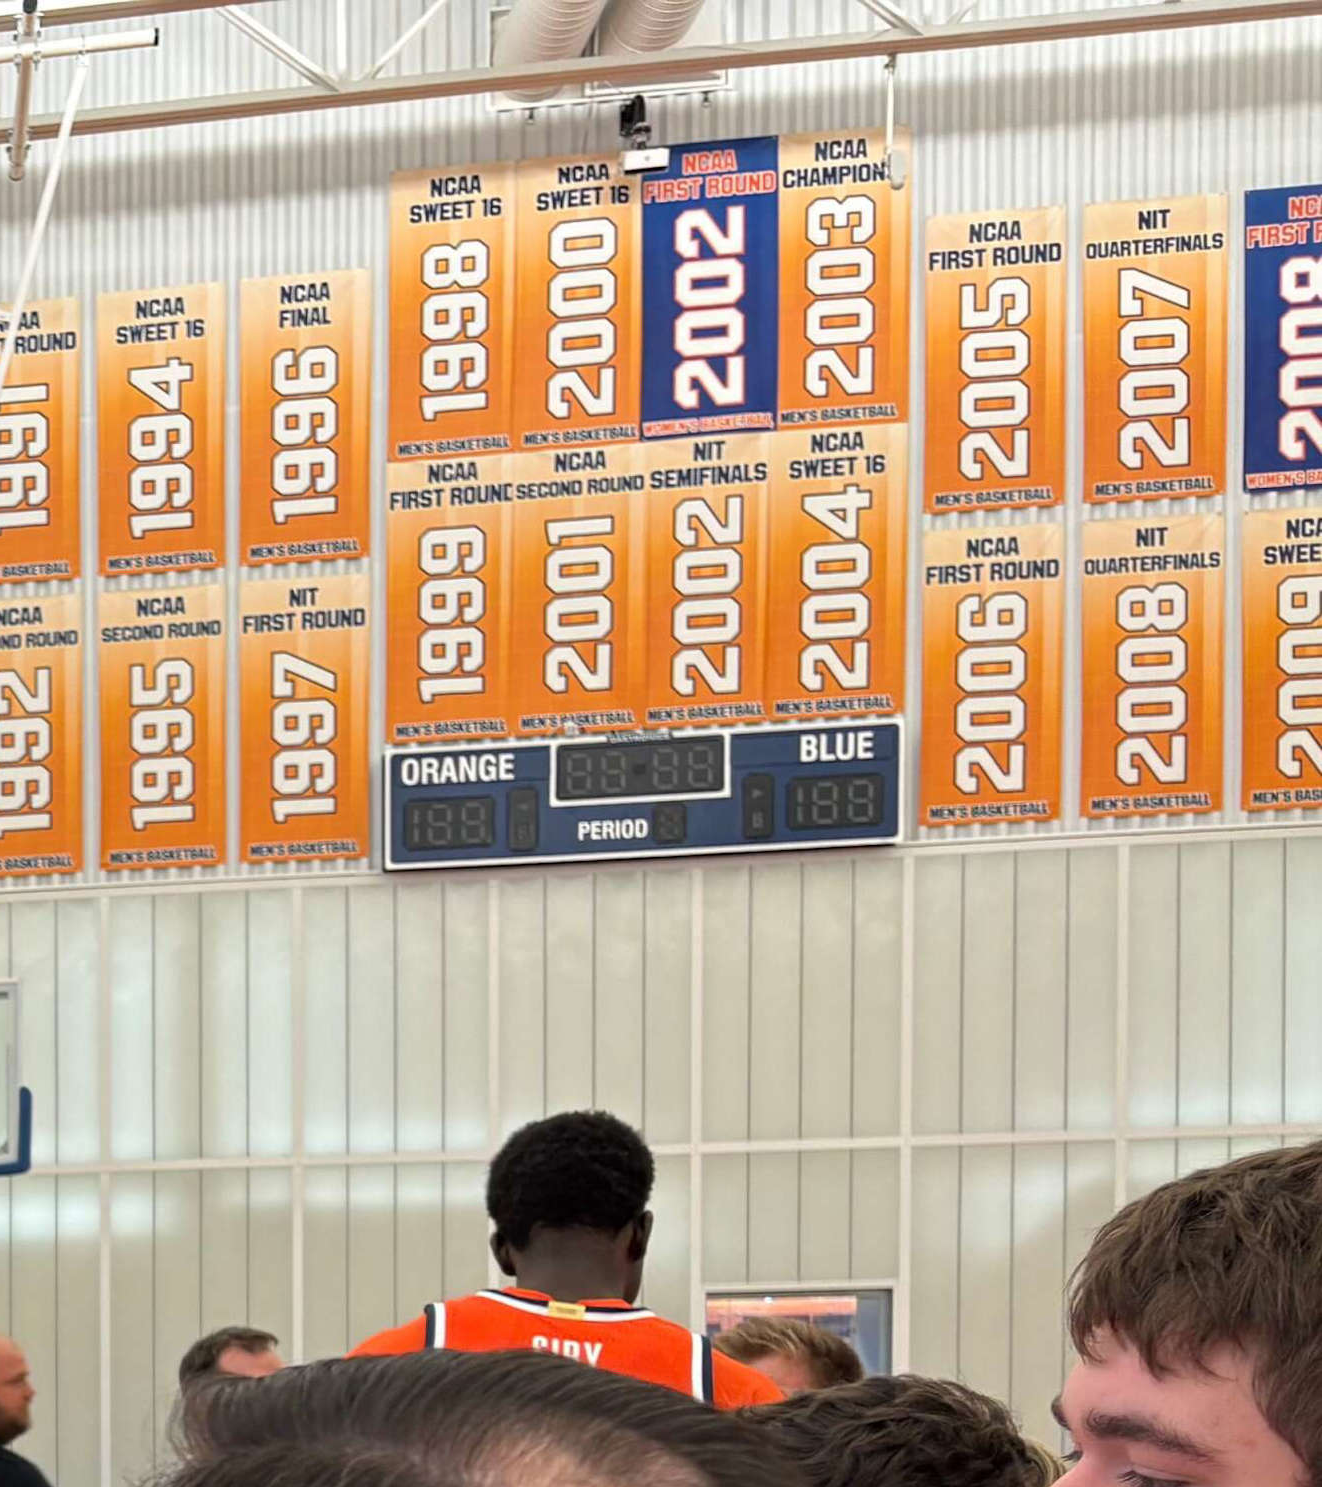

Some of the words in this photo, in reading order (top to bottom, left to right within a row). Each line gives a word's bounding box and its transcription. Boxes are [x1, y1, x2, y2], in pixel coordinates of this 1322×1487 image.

[814, 139, 867, 160] NCAA
[682, 151, 737, 173] NCAA
[430, 176, 481, 196] NCAA
[558, 164, 609, 185] NCAA
[642, 179, 703, 202] FIRST
[706, 171, 775, 195] ROUND
[537, 189, 606, 211] SWEET
[610, 186, 629, 204] 16
[410, 202, 478, 223] SWEET
[482, 199, 501, 217] 16
[1138, 210, 1171, 230] NIT
[969, 220, 1021, 243] NCAA
[929, 247, 989, 271] FIRST
[993, 243, 1061, 265] ROUND
[1086, 234, 1223, 259] QUARTERFINALS
[280, 282, 329, 303] NCAA
[806, 195, 875, 398] 2003
[279, 308, 331, 328] FINAL
[546, 217, 617, 419] 2000
[674, 204, 745, 410] 2002
[420, 239, 489, 421] 1998
[14, 332, 75, 354] ROUND
[960, 277, 1030, 481] 2005
[1118, 268, 1190, 469] 2007
[781, 410, 816, 424] MEN'S
[819, 405, 896, 420] BASKETBALL
[271, 346, 337, 524] 1996
[398, 440, 433, 456] MEN'S
[436, 436, 508, 452] BASKETBALL
[810, 432, 863, 453] NCAA
[128, 358, 193, 539] 1994
[693, 441, 725, 461] NIT
[650, 463, 767, 489] SEMIFINALS
[789, 458, 860, 479] SWEET
[864, 455, 885, 474] 16
[935, 493, 973, 505] MEN'S
[976, 488, 1052, 504] BASKETBALL
[1095, 482, 1133, 496] MEN'S
[1136, 478, 1212, 493] BASKETBALL
[250, 544, 285, 558] MEN'S
[289, 540, 358, 556] BASKETBALL
[966, 537, 1019, 558] NCAA
[1136, 527, 1168, 547] NIT
[926, 564, 985, 585] FIRST
[990, 559, 1059, 581] ROUND
[1084, 552, 1220, 575] QUARTERFINALS
[289, 588, 319, 607] NIT
[672, 495, 743, 696] 2002
[800, 485, 871, 692] 2004
[418, 525, 486, 704] 1999
[544, 516, 613, 693] 2001
[243, 613, 297, 634] FIRST
[301, 609, 365, 629] ROUND
[27, 628, 78, 647] ROUND
[954, 592, 1028, 794] 2006
[1116, 582, 1188, 786] 2008
[131, 658, 195, 830] 1995
[271, 651, 336, 823] 1997
[800, 732, 874, 762] BLUE
[401, 755, 515, 786] ORANGE
[929, 805, 968, 820] MEN'S
[971, 802, 1048, 818] BASKETBALL
[1092, 798, 1131, 811] MEN'S
[1134, 793, 1210, 809] BASKETBALL
[578, 819, 648, 841] PERIOD
